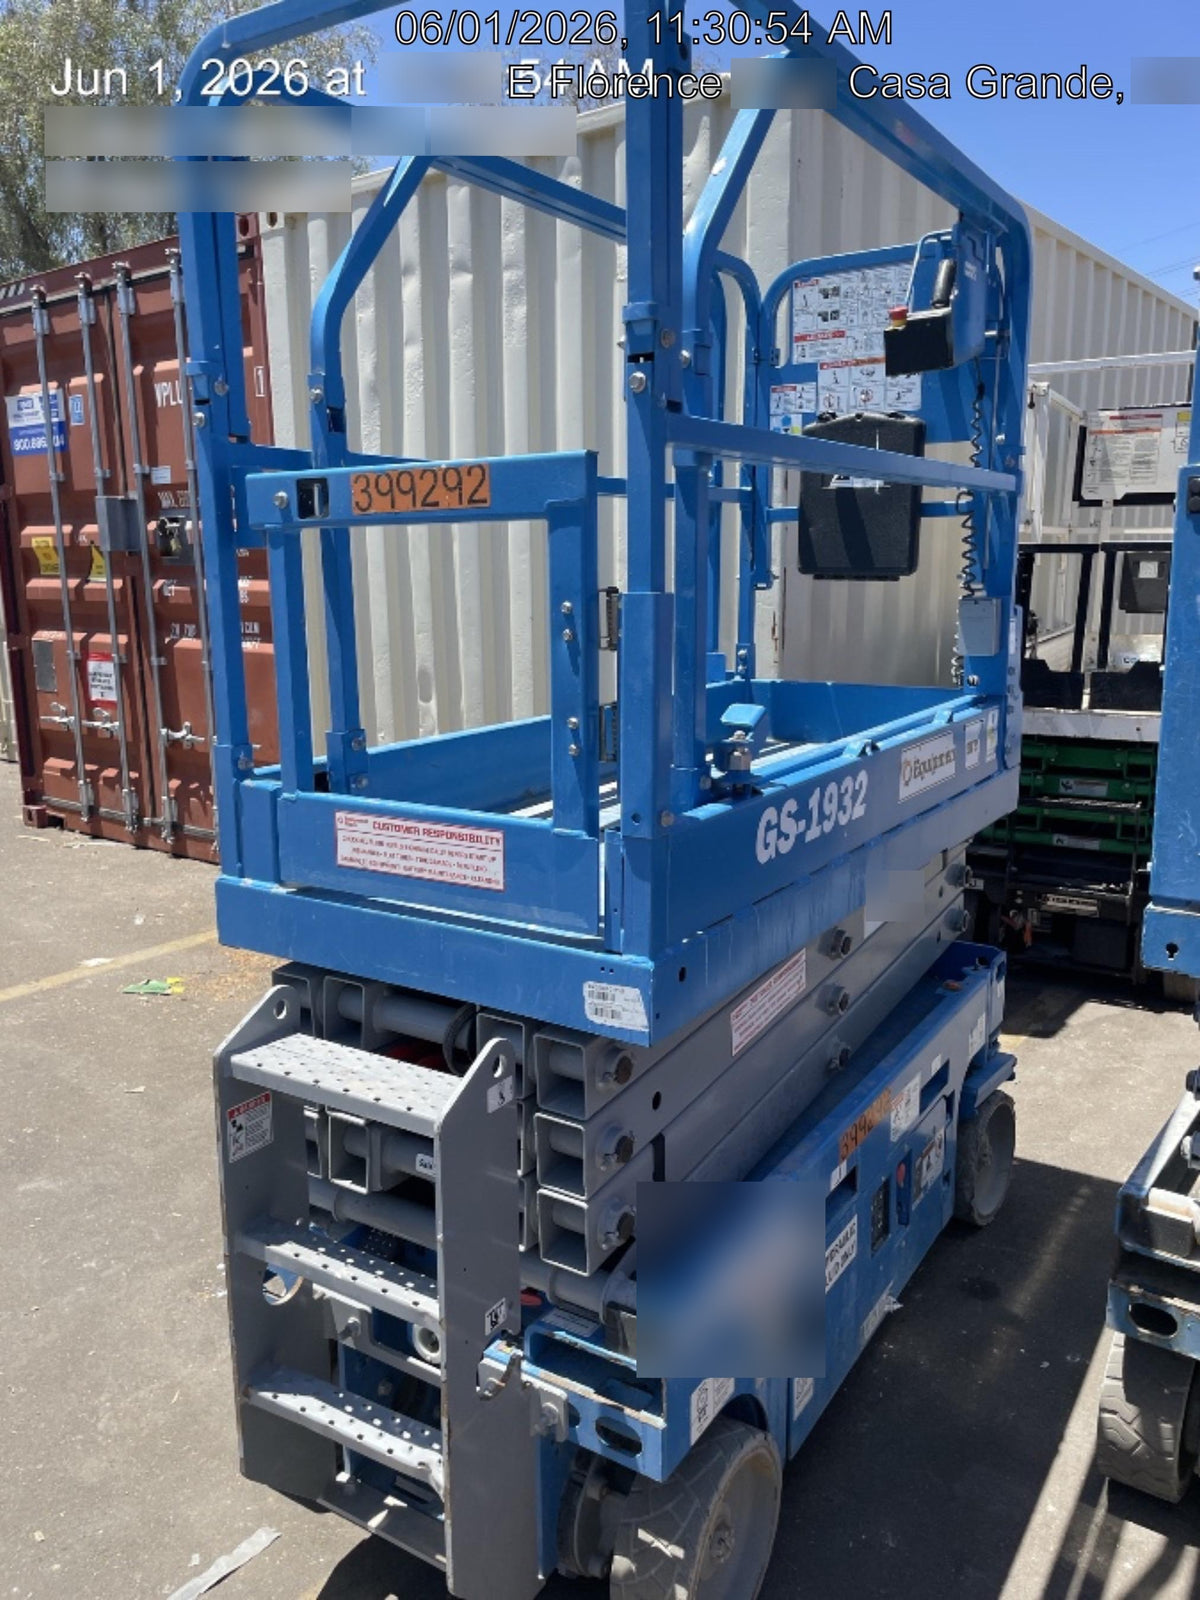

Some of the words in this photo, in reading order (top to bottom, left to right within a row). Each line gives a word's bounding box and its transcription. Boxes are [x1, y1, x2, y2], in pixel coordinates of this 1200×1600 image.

[354, 464, 487, 512] 399292
[372, 820, 420, 837] CUSTOMER
[422, 828, 501, 847] RESPONSIBILITY
[755, 769, 868, 864] GS-1932
